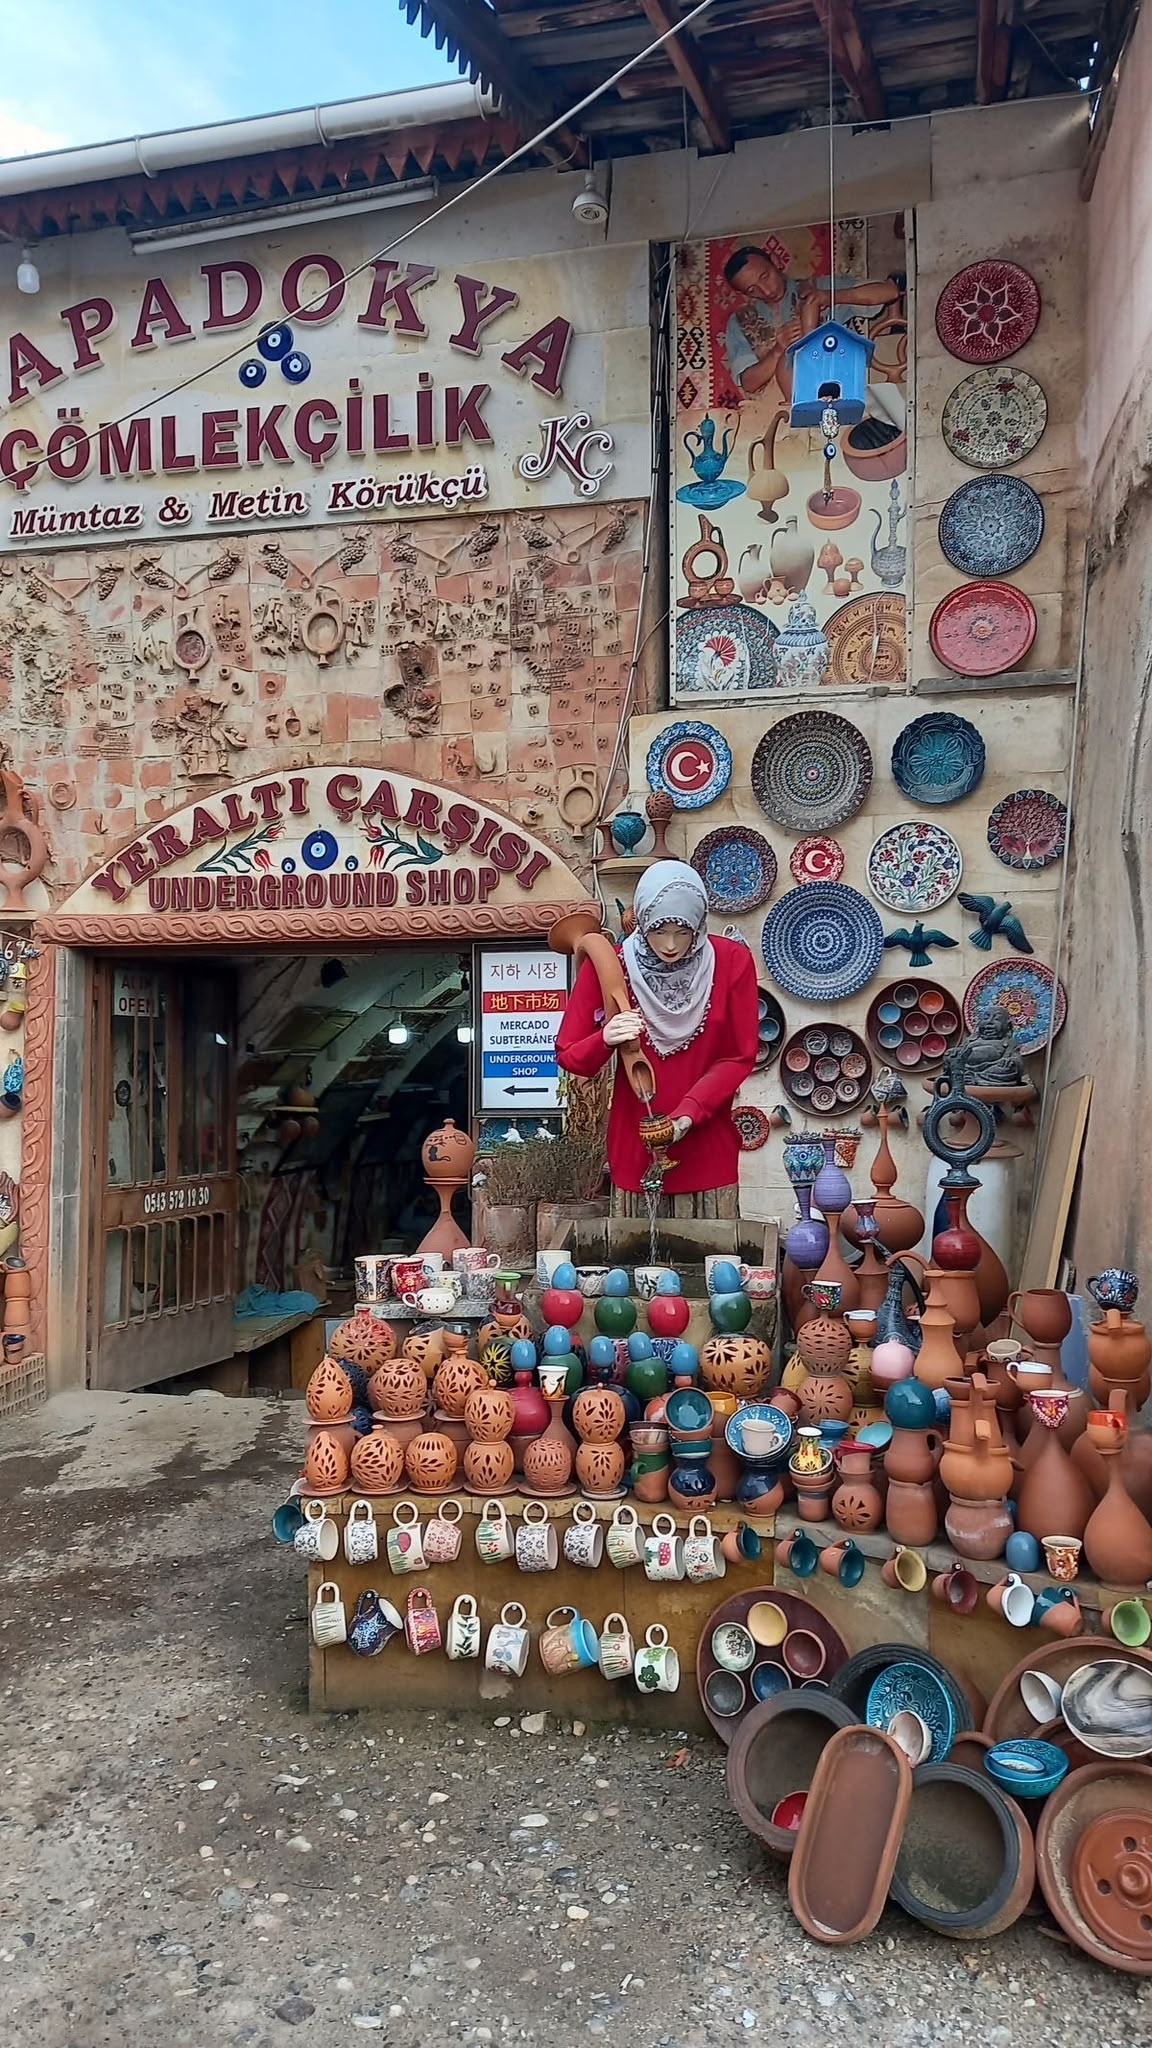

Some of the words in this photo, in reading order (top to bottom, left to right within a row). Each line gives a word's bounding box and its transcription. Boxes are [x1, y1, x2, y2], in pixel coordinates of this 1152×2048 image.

[0, 252, 576, 410] APADOKYA
[0, 373, 494, 491] ÇÖMLEKÇİLİK
[9, 503, 142, 537] Mümtaz
[157, 495, 190, 524] &
[210, 484, 304, 520] Metin
[330, 466, 487, 509] Körükçü
[91, 776, 309, 901] YERALTI
[324, 773, 553, 890] ÇARŞISI
[148, 872, 398, 910] UNDERGROUND
[405, 866, 501, 904] SHOP
[490, 963, 521, 980] 지하
[527, 962, 559, 979] 시장
[490, 993, 560, 1011] 地下市场
[500, 1020, 550, 1031] MERCADO
[511, 1067, 538, 1077] SHOP
[169, 1190, 185, 1210] 572
[198, 1186, 210, 1206] 30
